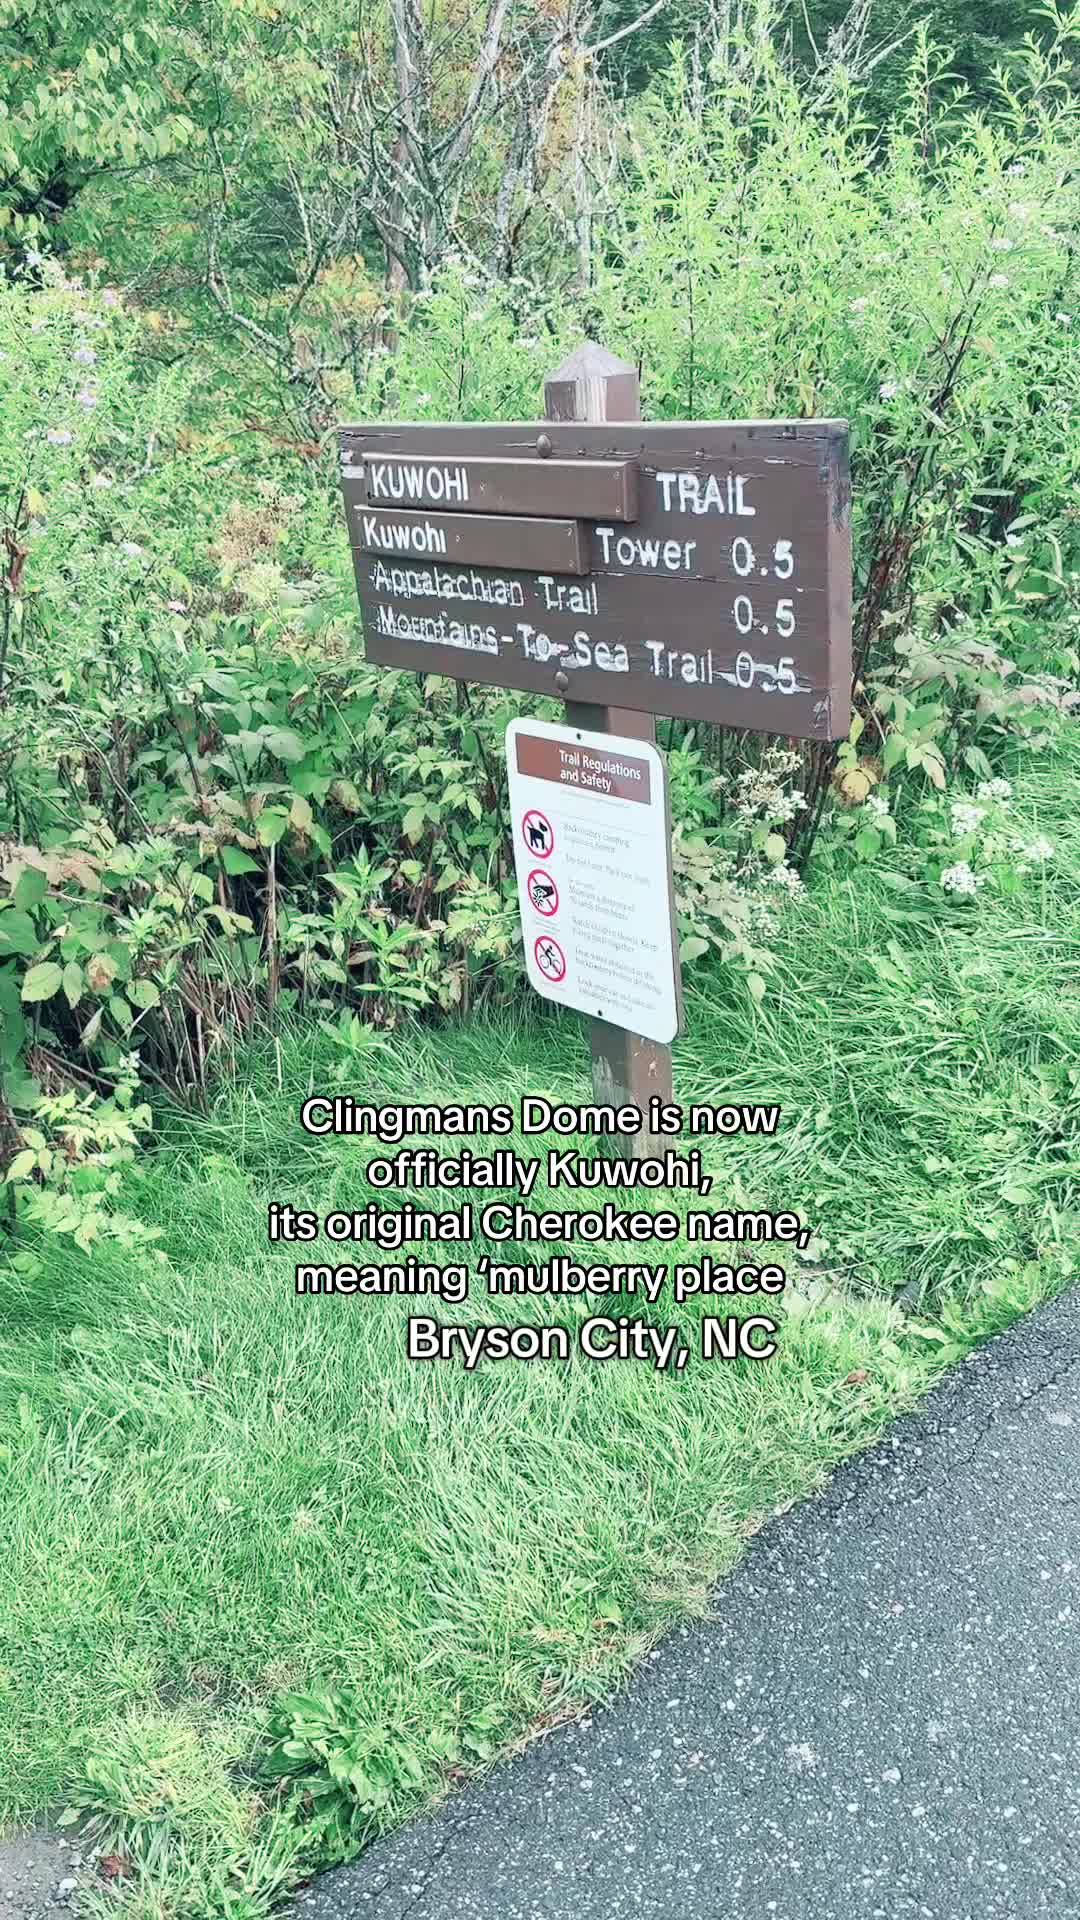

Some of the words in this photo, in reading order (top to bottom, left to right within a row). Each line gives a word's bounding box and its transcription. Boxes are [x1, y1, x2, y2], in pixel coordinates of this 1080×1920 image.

[371, 464, 469, 501] KUWOHI
[656, 472, 756, 516] TRAIL
[363, 516, 447, 553] Kuwohi
[595, 527, 697, 570] Tower
[731, 537, 794, 579] 0.5
[372, 560, 525, 607] Appalachian
[537, 576, 599, 615] Trail
[733, 595, 796, 638] 0.5
[646, 640, 713, 684] Trail
[735, 651, 797, 694] 0.5
[559, 749, 581, 767] Trail
[583, 755, 641, 780] Regulations
[560, 768, 579, 782] and
[581, 770, 612, 792] Safety
